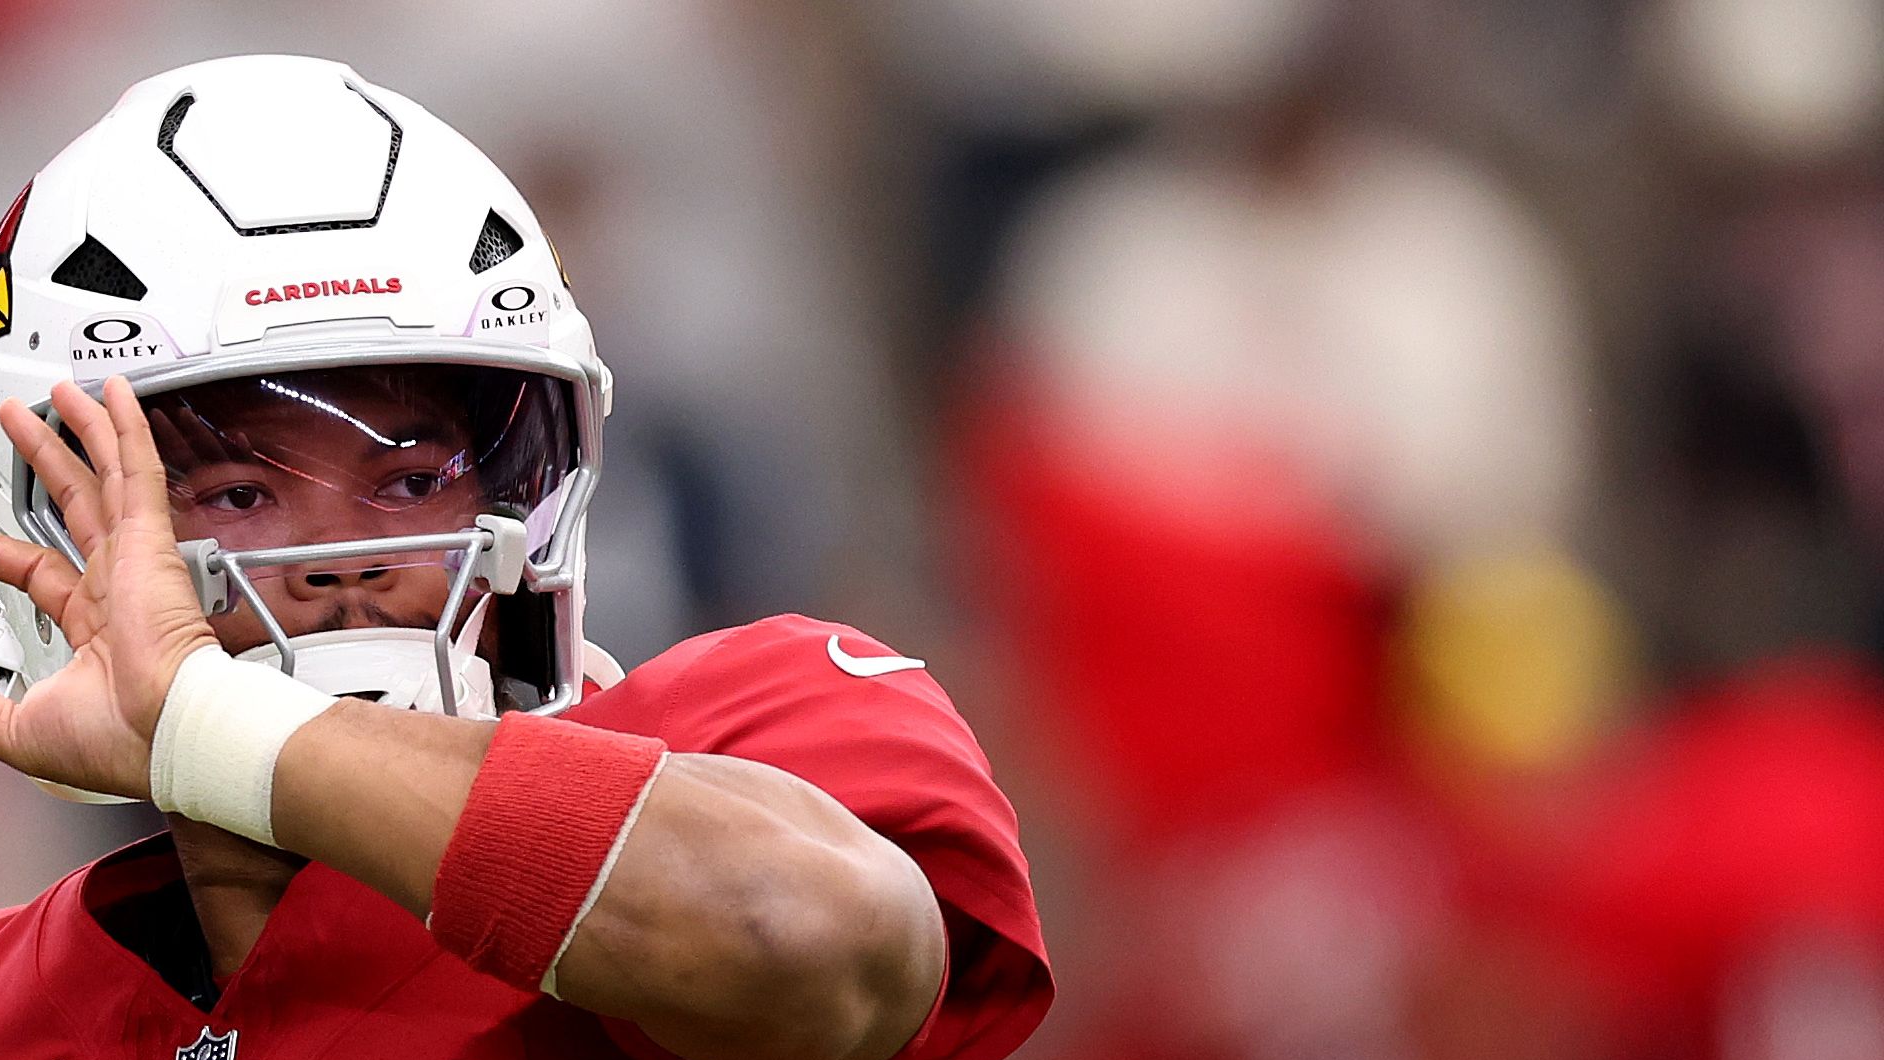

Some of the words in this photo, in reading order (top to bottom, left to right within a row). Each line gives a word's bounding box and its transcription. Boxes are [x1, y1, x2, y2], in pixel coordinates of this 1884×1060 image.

[245, 277, 403, 306] CARDINALS
[481, 310, 546, 329] OAKLEY
[72, 344, 159, 361] OAKLEY
